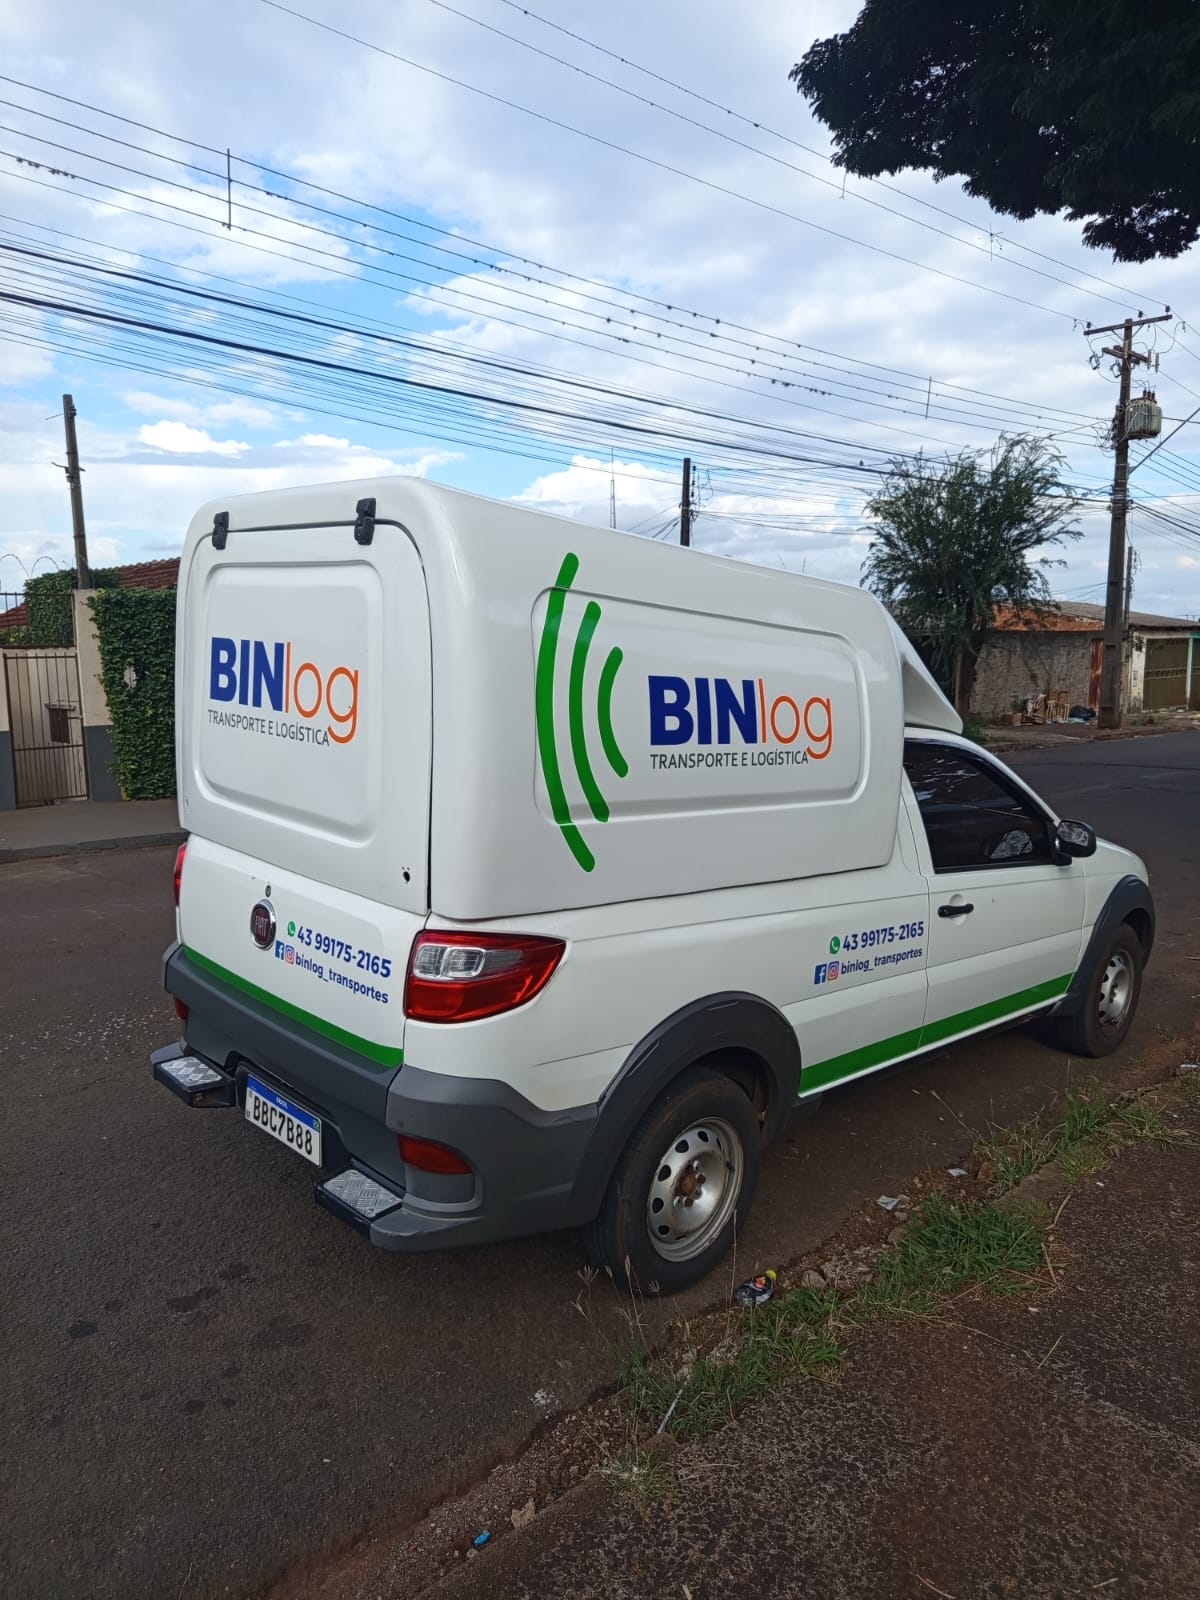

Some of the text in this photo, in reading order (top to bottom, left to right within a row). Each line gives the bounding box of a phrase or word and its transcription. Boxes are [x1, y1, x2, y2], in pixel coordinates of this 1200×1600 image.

[210, 637, 359, 744] BINlog
[208, 709, 329, 746] TRANSPORTE E LOGÍSTICA
[648, 675, 832, 760] BINlog
[650, 748, 808, 769] TRANSPORTE E LOGÍSTICA
[297, 926, 392, 978] 43 99175-2165
[841, 948, 922, 974] binlog_transportes
[843, 921, 924, 951] 43 99175-2165
[295, 952, 389, 1003] binlog_transportes
[253, 1095, 312, 1155] BBC7B88
